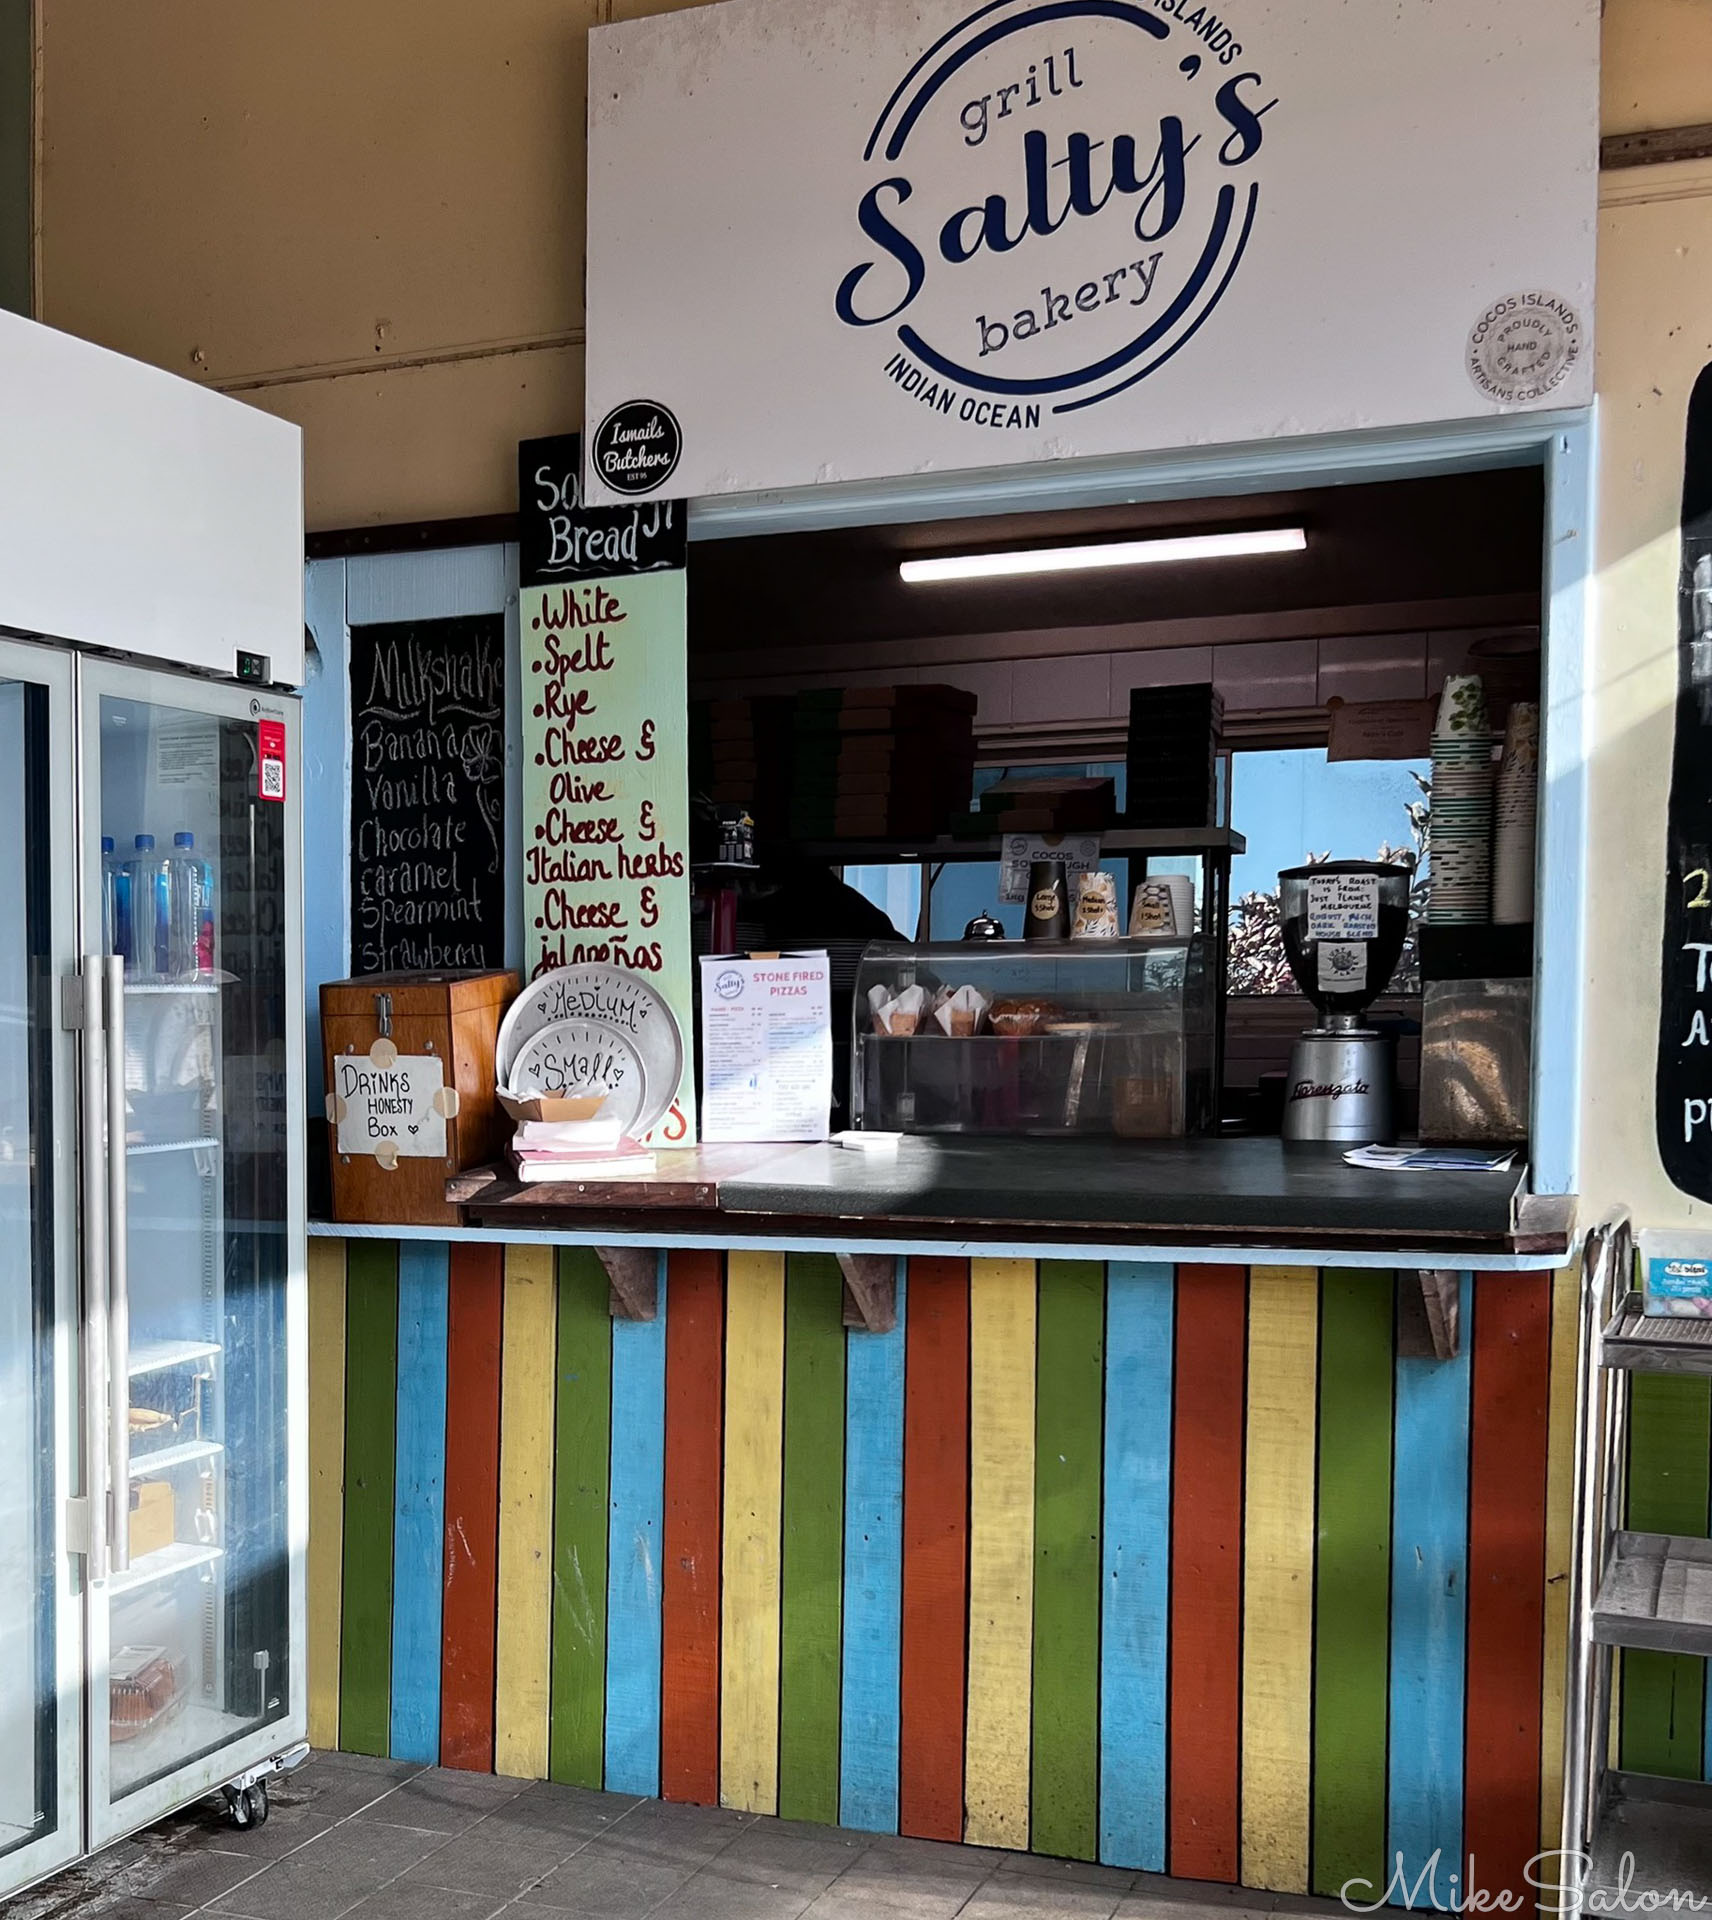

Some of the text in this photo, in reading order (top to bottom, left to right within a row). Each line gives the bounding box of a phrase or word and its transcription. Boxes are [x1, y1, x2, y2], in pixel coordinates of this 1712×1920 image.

[959, 47, 1083, 147] grill
[835, 54, 1279, 326] Salty's
[977, 252, 1163, 356] bakery
[1472, 293, 1578, 344] COCOS ISLANDS
[1497, 318, 1552, 343] PROUDLY
[1507, 341, 1537, 352] HAND
[1471, 346, 1579, 401] ARTISANS COLLECTIVE
[1497, 351, 1550, 375] CRAFTED
[883, 352, 1041, 429] INDIAN OCEAN
[610, 415, 665, 445] Ismails
[602, 445, 671, 473] Butchers
[547, 510, 639, 564] Bread
[541, 585, 627, 630] White
[544, 630, 615, 678] Spelt
[544, 678, 598, 732] Rye
[360, 719, 460, 772] Banana
[544, 727, 626, 768] Cheese
[549, 772, 615, 804] Olive
[358, 812, 467, 862] Chocolate
[544, 806, 625, 846] Cheese
[526, 841, 685, 885] Italian herbs
[1031, 851, 1074, 860] COCOS
[1349, 877, 1377, 885] ROAST
[544, 887, 628, 930] Cheese
[753, 971, 824, 982] STONE FIRED
[770, 986, 807, 996] PIZZAS
[367, 1098, 413, 1115] HONESTY
